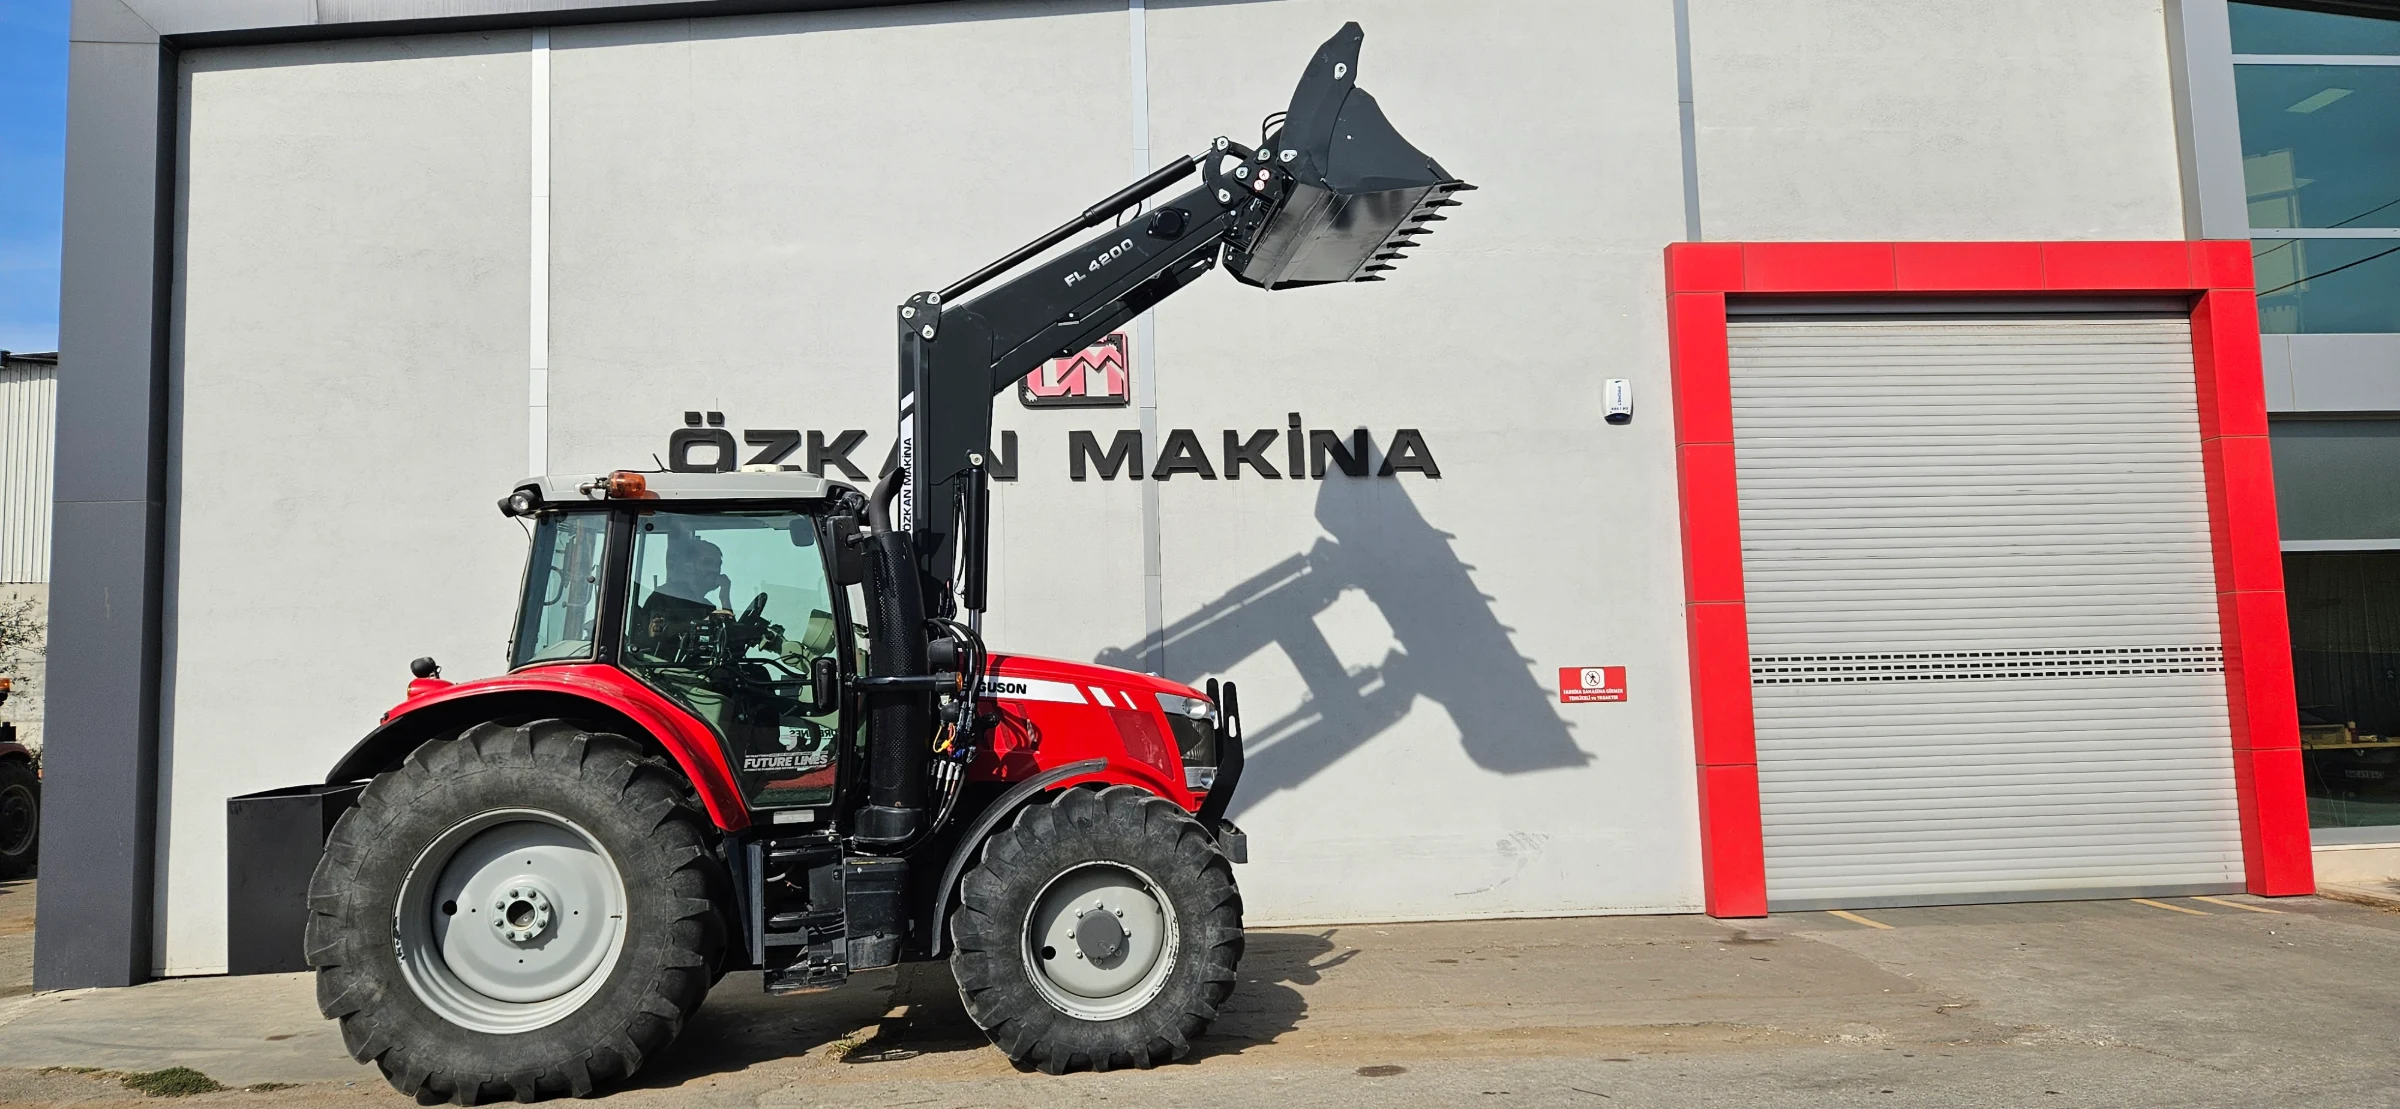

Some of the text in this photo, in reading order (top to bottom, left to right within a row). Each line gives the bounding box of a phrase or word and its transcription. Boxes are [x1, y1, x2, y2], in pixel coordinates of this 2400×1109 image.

[1064, 238, 1134, 287] FL 4200
[669, 411, 1442, 482] ÖZKN MAKİNA
[902, 438, 912, 531] ÖZKAN MAKİNA
[962, 682, 1027, 695] GUSON
[743, 756, 792, 769] FUTURE
[794, 754, 828, 766] LINES
